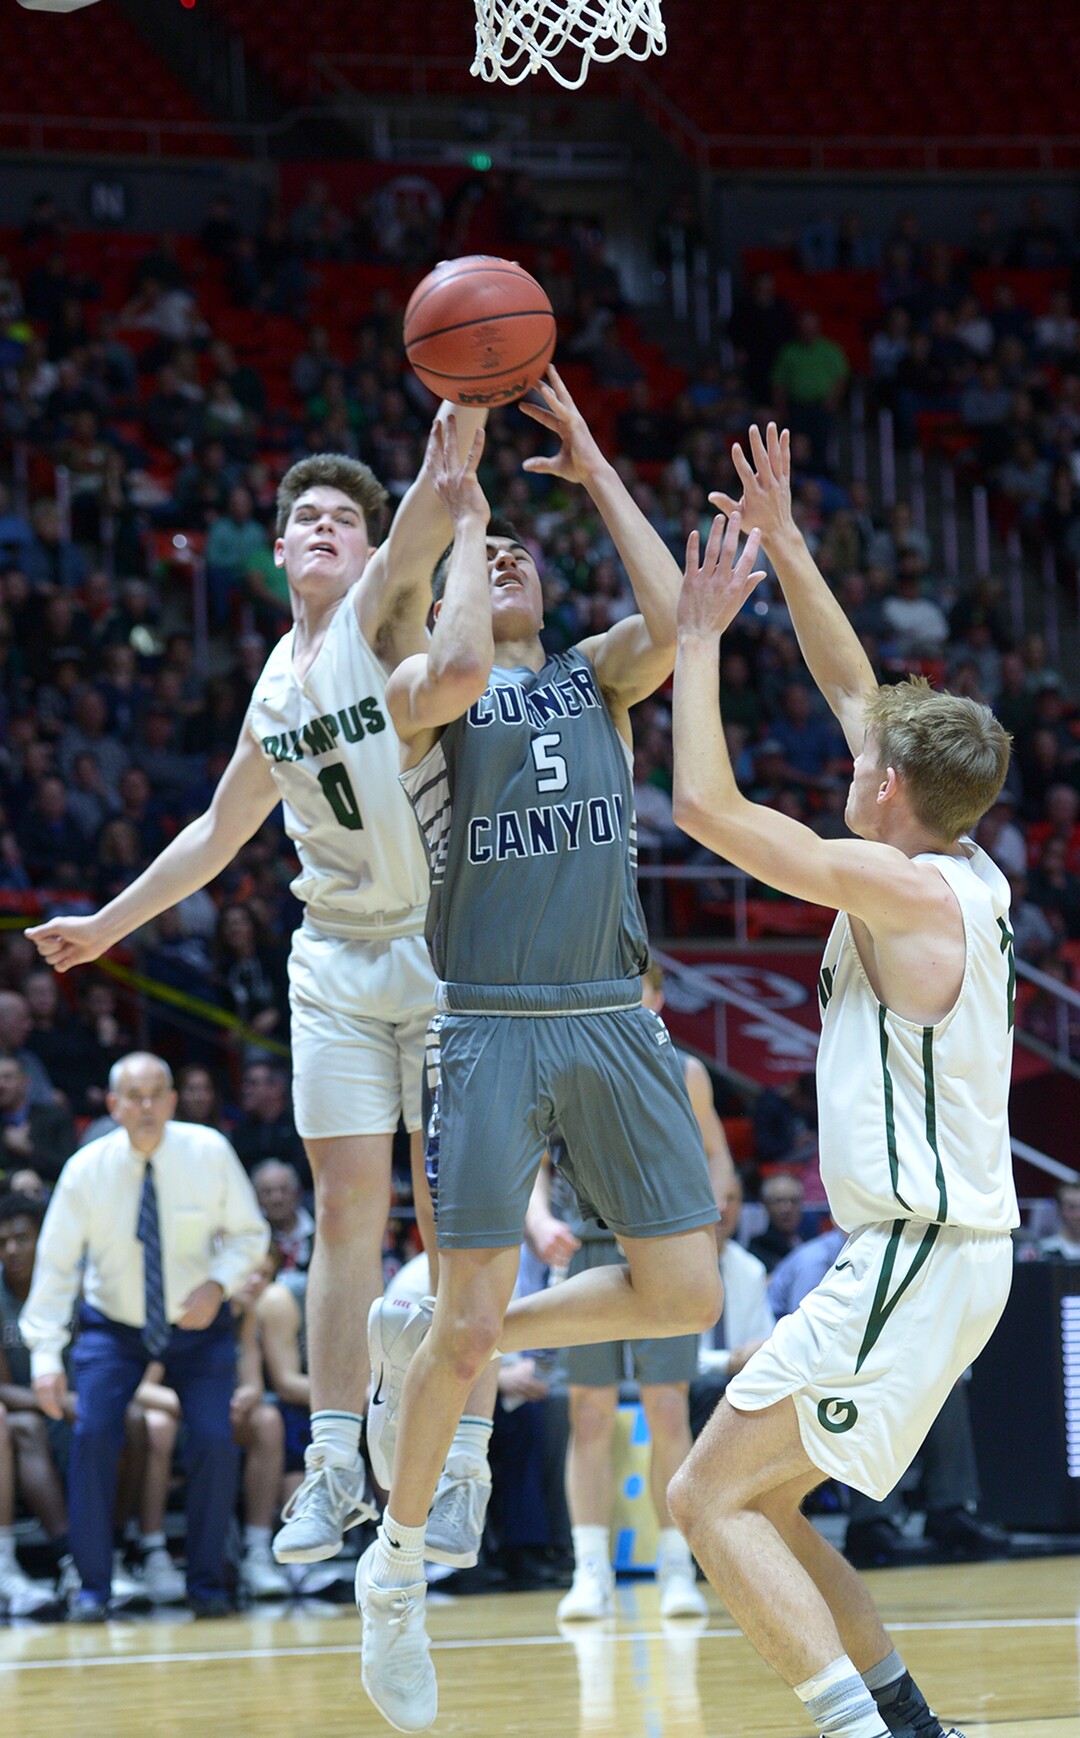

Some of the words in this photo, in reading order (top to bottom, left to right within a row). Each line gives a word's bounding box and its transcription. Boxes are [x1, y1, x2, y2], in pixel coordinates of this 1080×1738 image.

[262, 696, 386, 763] OLYMPUS
[531, 732, 569, 794] 5
[318, 762, 364, 831] 0
